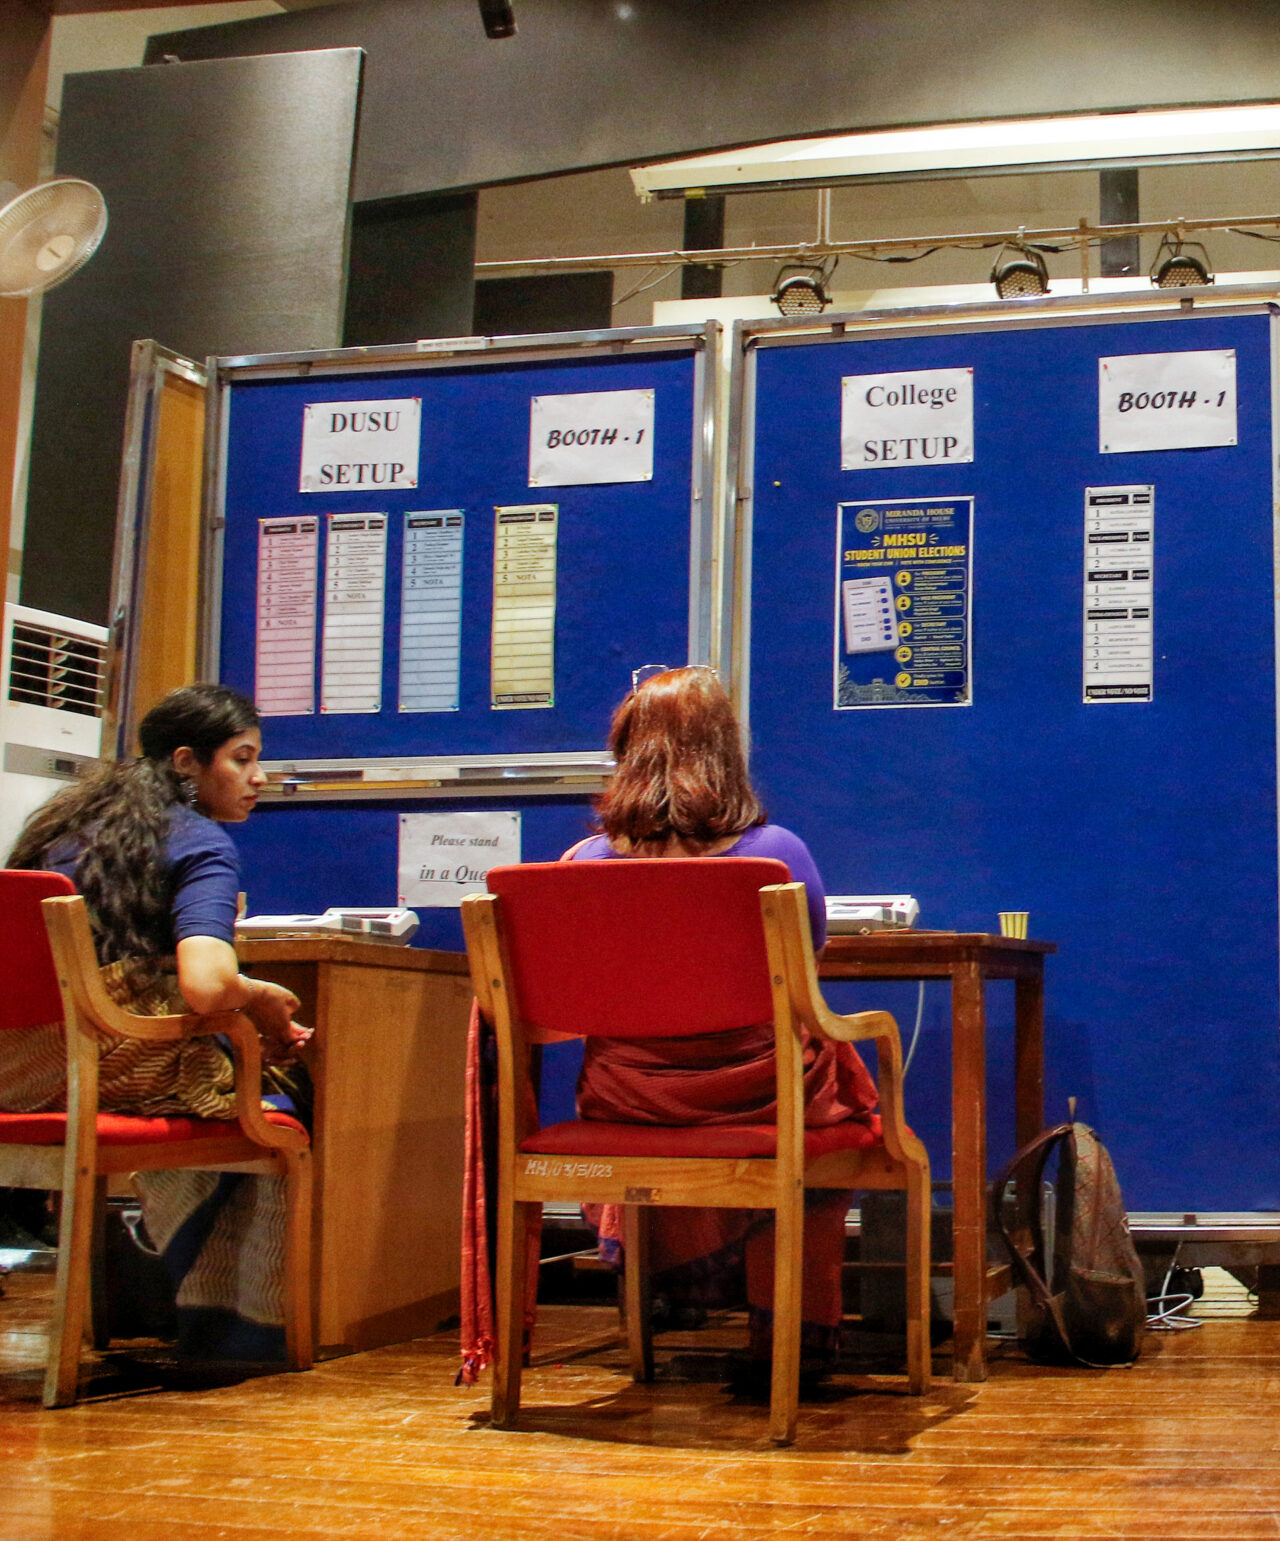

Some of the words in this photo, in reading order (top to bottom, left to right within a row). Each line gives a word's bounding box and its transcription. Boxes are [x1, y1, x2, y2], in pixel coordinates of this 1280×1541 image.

[866, 384, 957, 409] College
[1118, 391, 1196, 412] BOOTH
[1217, 391, 1226, 407] 1
[330, 412, 400, 432] DUSU
[547, 428, 618, 449] BOOTH
[636, 429, 645, 444] 1
[864, 437, 957, 461] SETUP
[320, 463, 404, 484] SETUP
[1096, 509, 1100, 518] 1
[1095, 522, 1100, 530] 2
[883, 533, 927, 546] MHSU
[844, 549, 885, 561] STUDENT
[887, 547, 916, 559] UNION
[918, 546, 965, 557] ELECTIONS
[1095, 547, 1099, 555] 1
[1094, 560, 1100, 568] 2
[1095, 585, 1099, 594] 1
[1094, 598, 1100, 606] 2
[1094, 623, 1098, 632] 1
[1094, 636, 1099, 645] 2
[1093, 649, 1099, 658] 3
[1094, 662, 1099, 670] 4
[431, 835, 466, 846] Please
[469, 836, 499, 847] stand
[419, 864, 434, 880] in
[440, 870, 450, 879] a
[455, 865, 488, 884] Que
